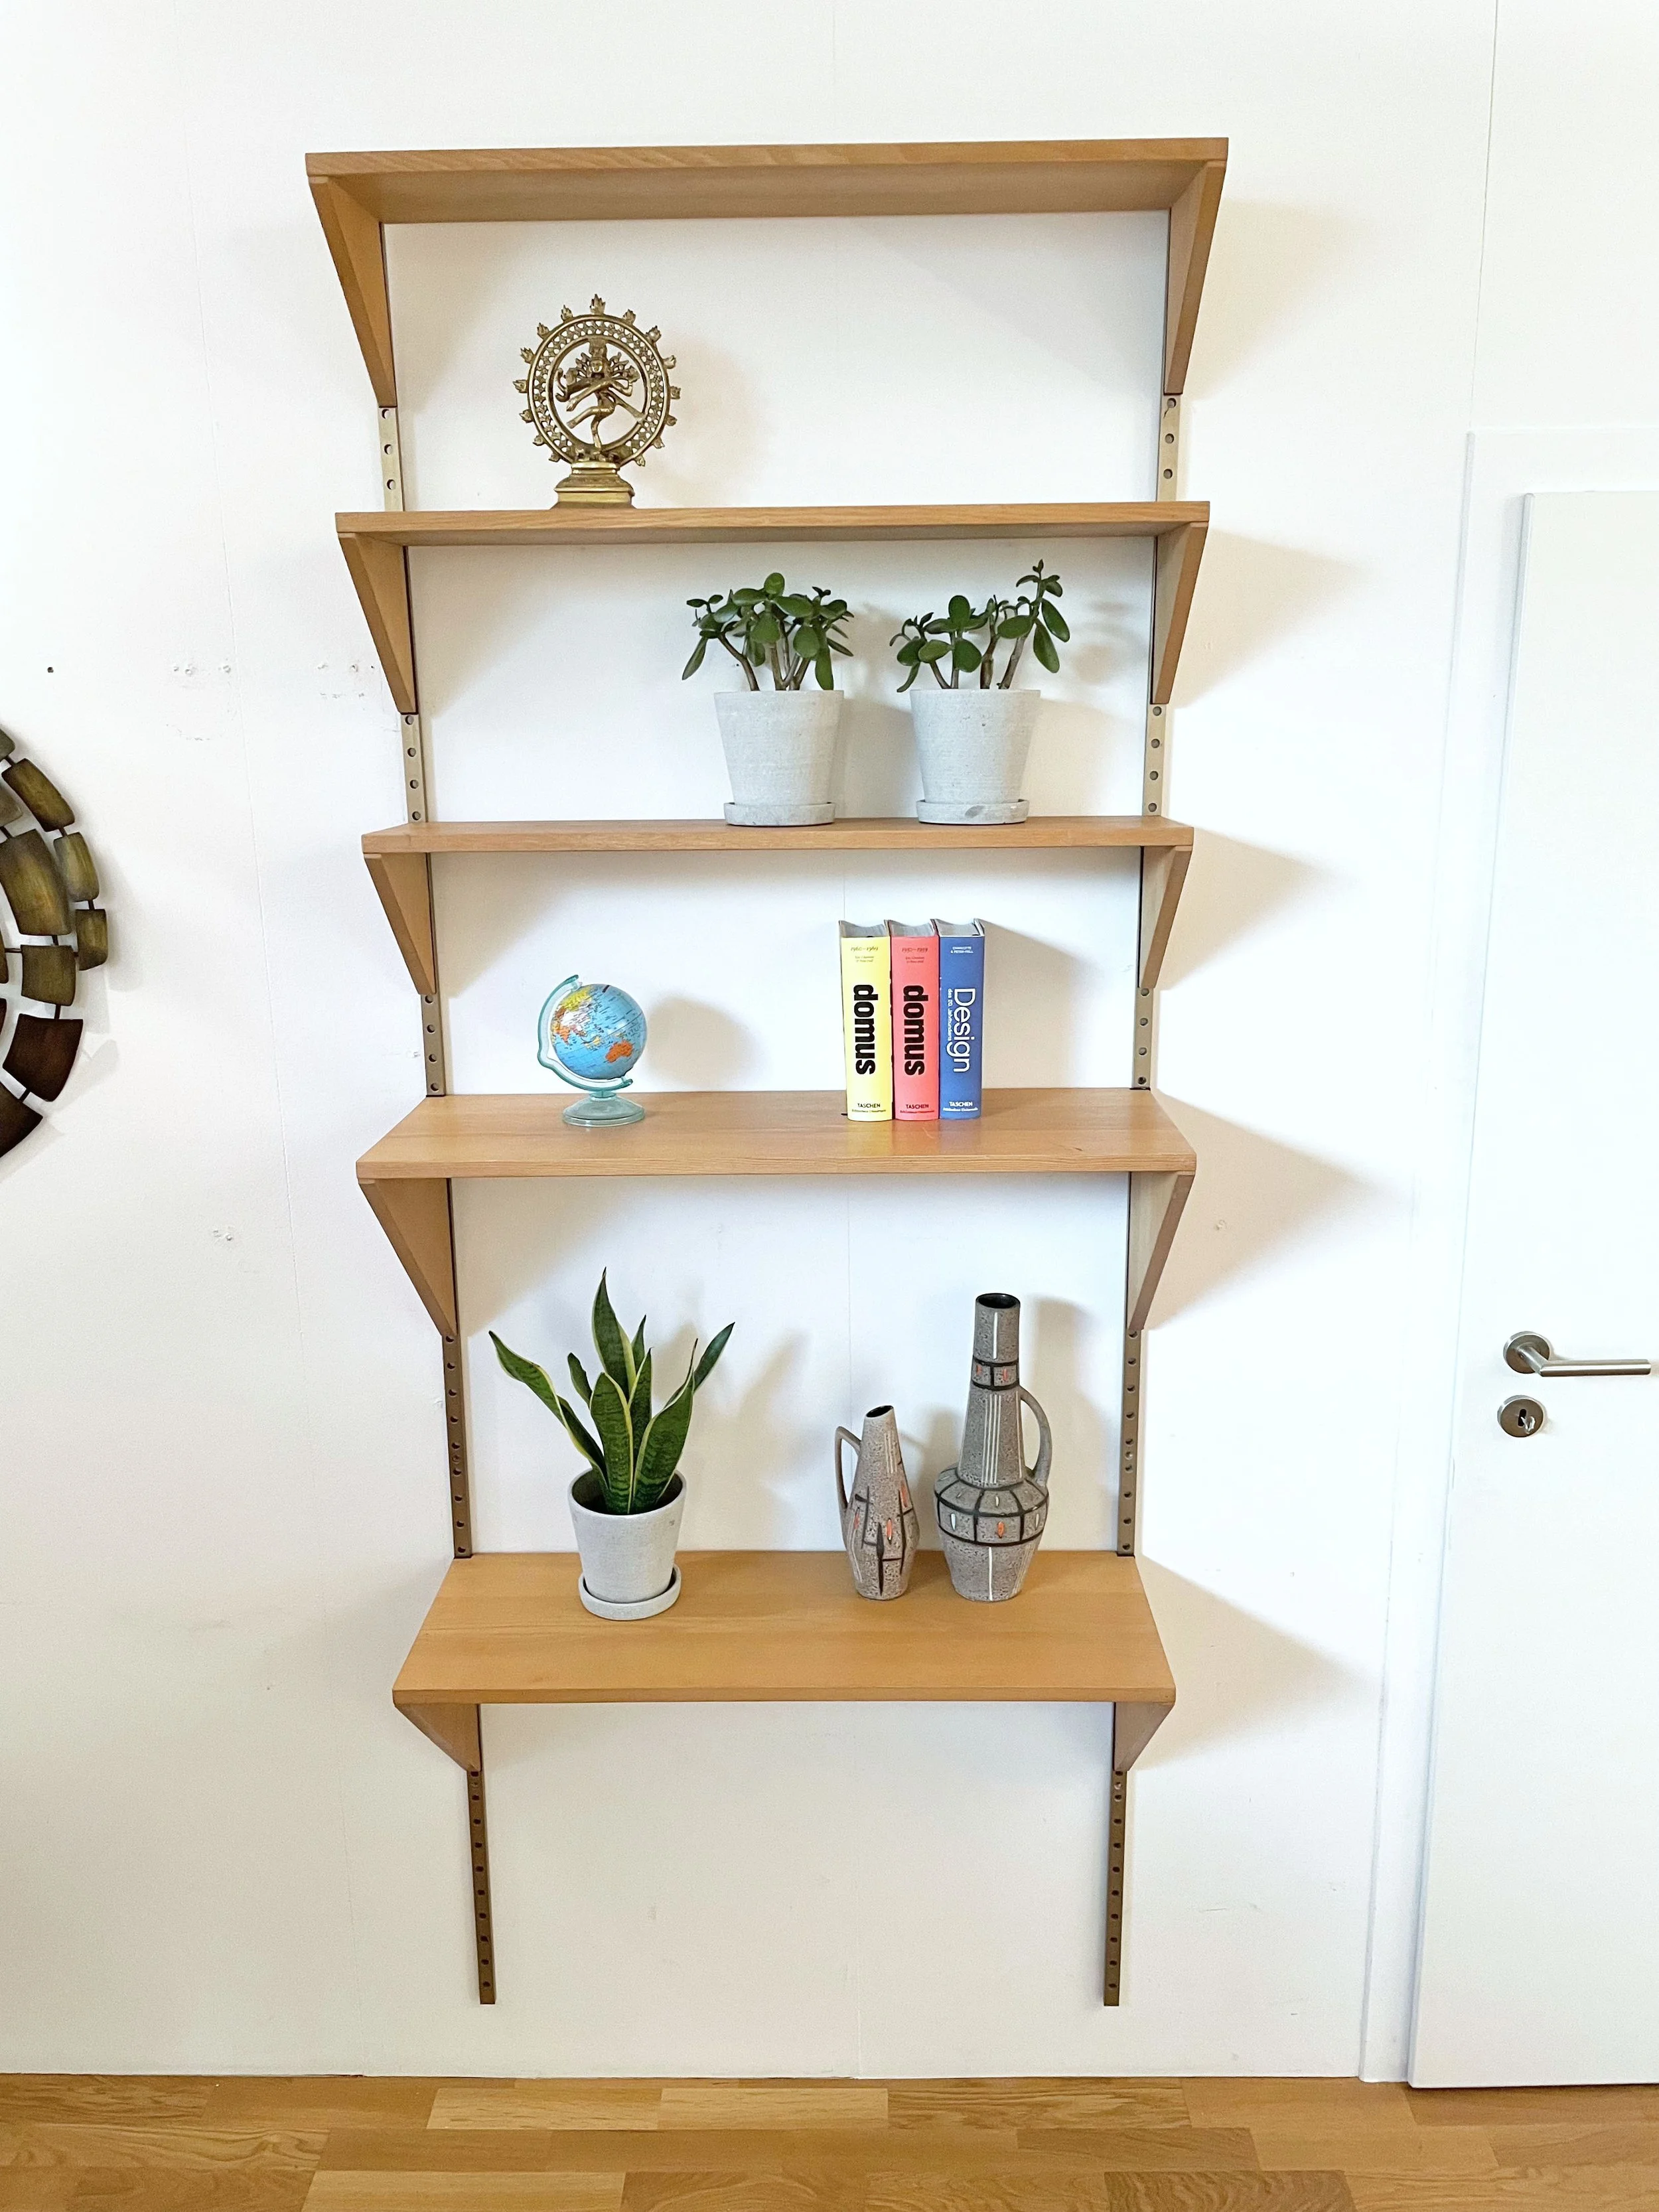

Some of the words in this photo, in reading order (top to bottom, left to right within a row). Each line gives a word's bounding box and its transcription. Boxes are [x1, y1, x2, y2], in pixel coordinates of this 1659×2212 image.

[853, 984, 878, 1074] domus
[903, 985, 928, 1075] domus
[946, 988, 975, 1072] Design
